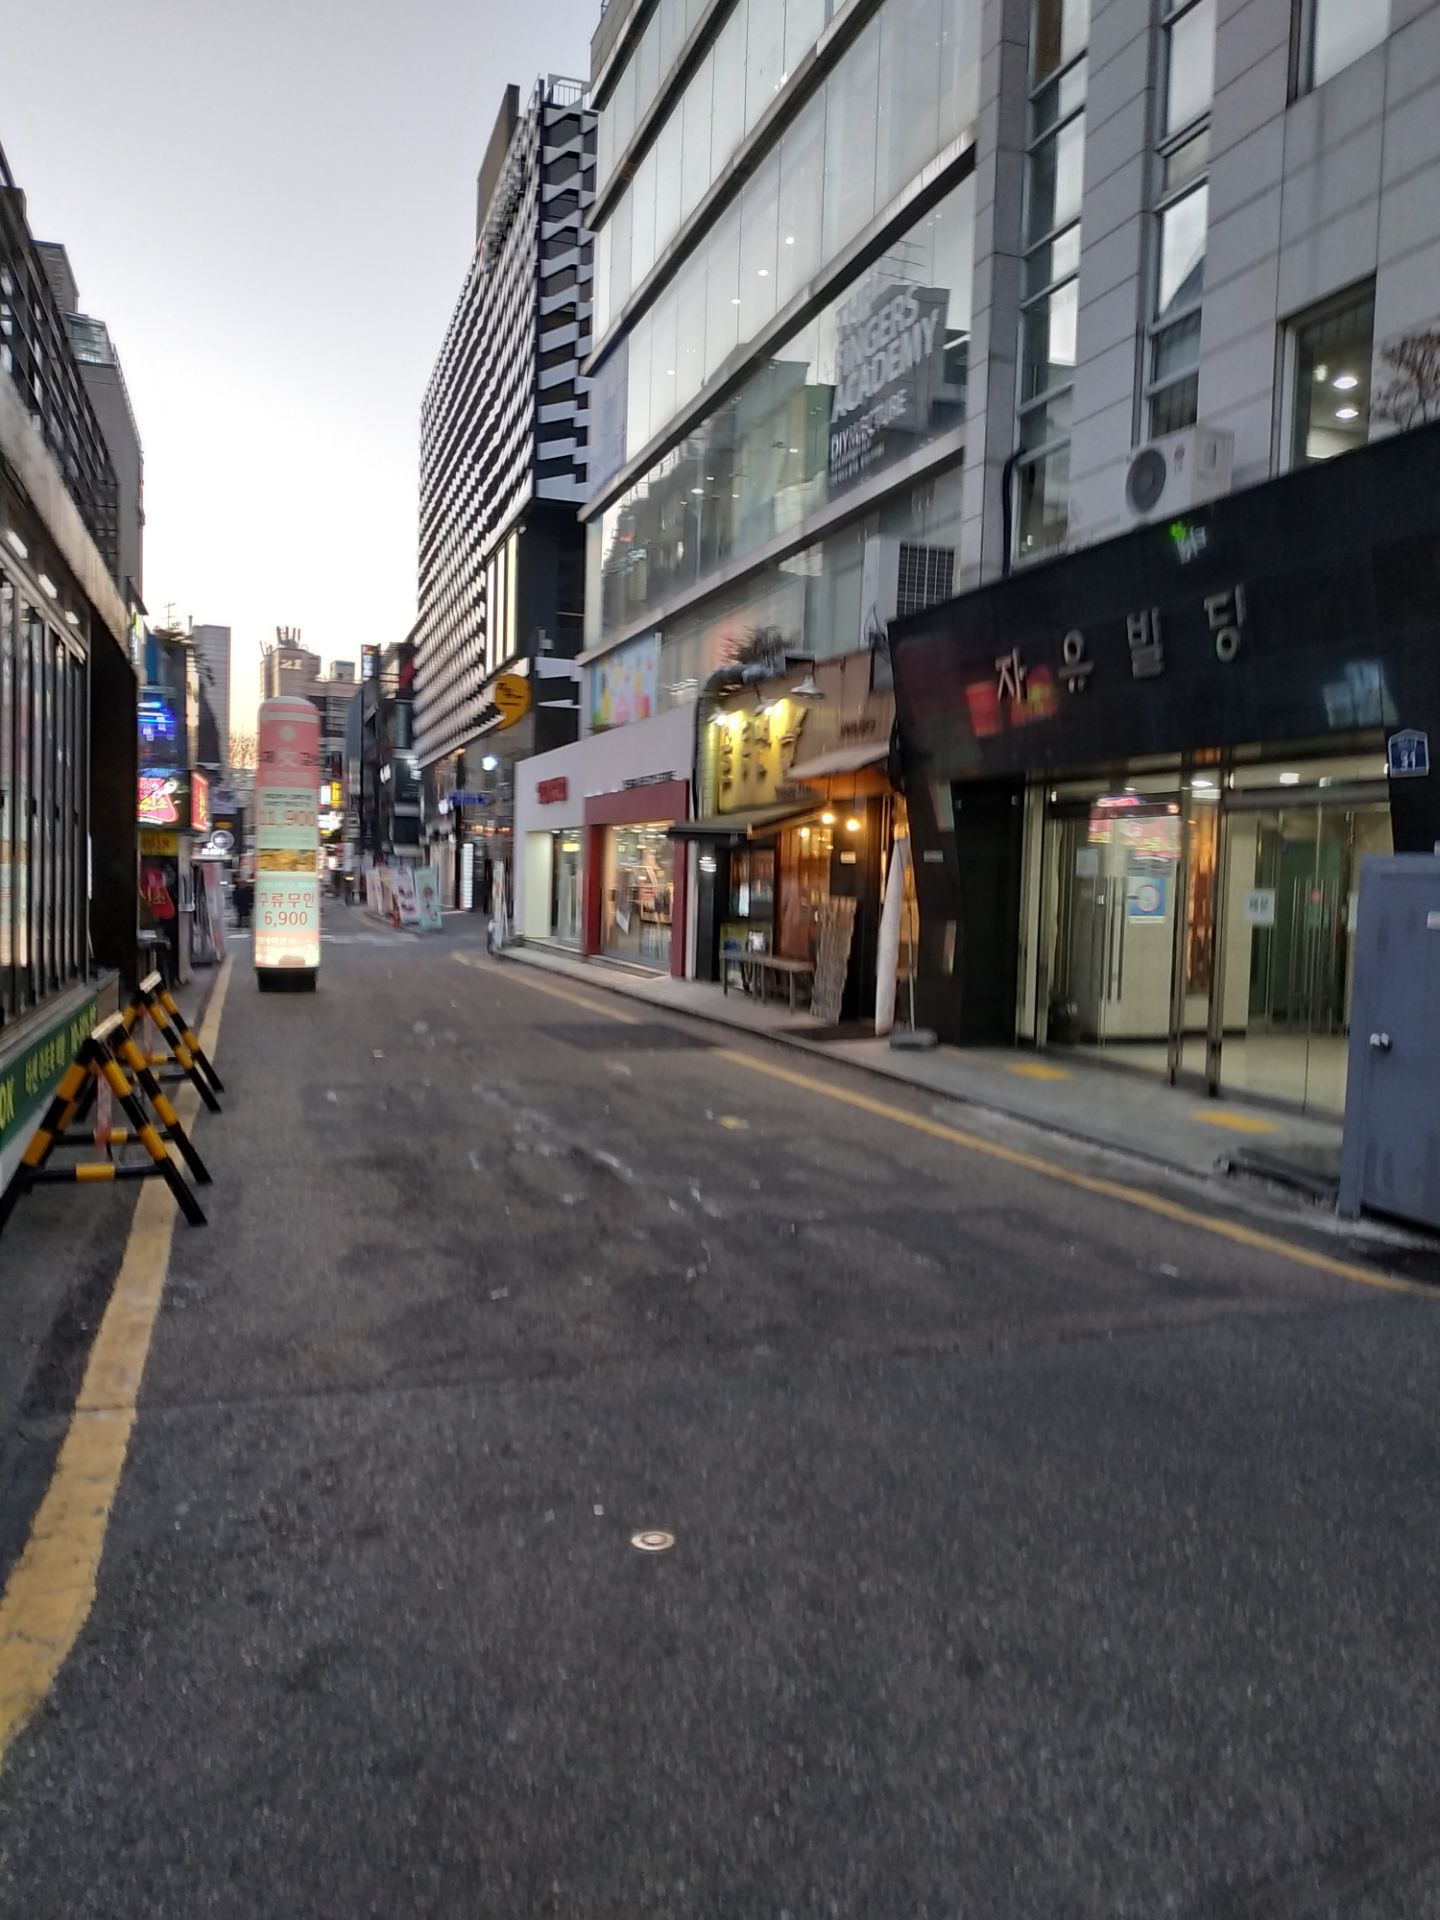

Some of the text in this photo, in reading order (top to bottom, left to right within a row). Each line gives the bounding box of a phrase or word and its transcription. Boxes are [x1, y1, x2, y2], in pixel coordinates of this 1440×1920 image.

[830, 307, 939, 423] ACADEMY
[831, 428, 849, 463] DIY
[264, 910, 308, 928] 6,900
